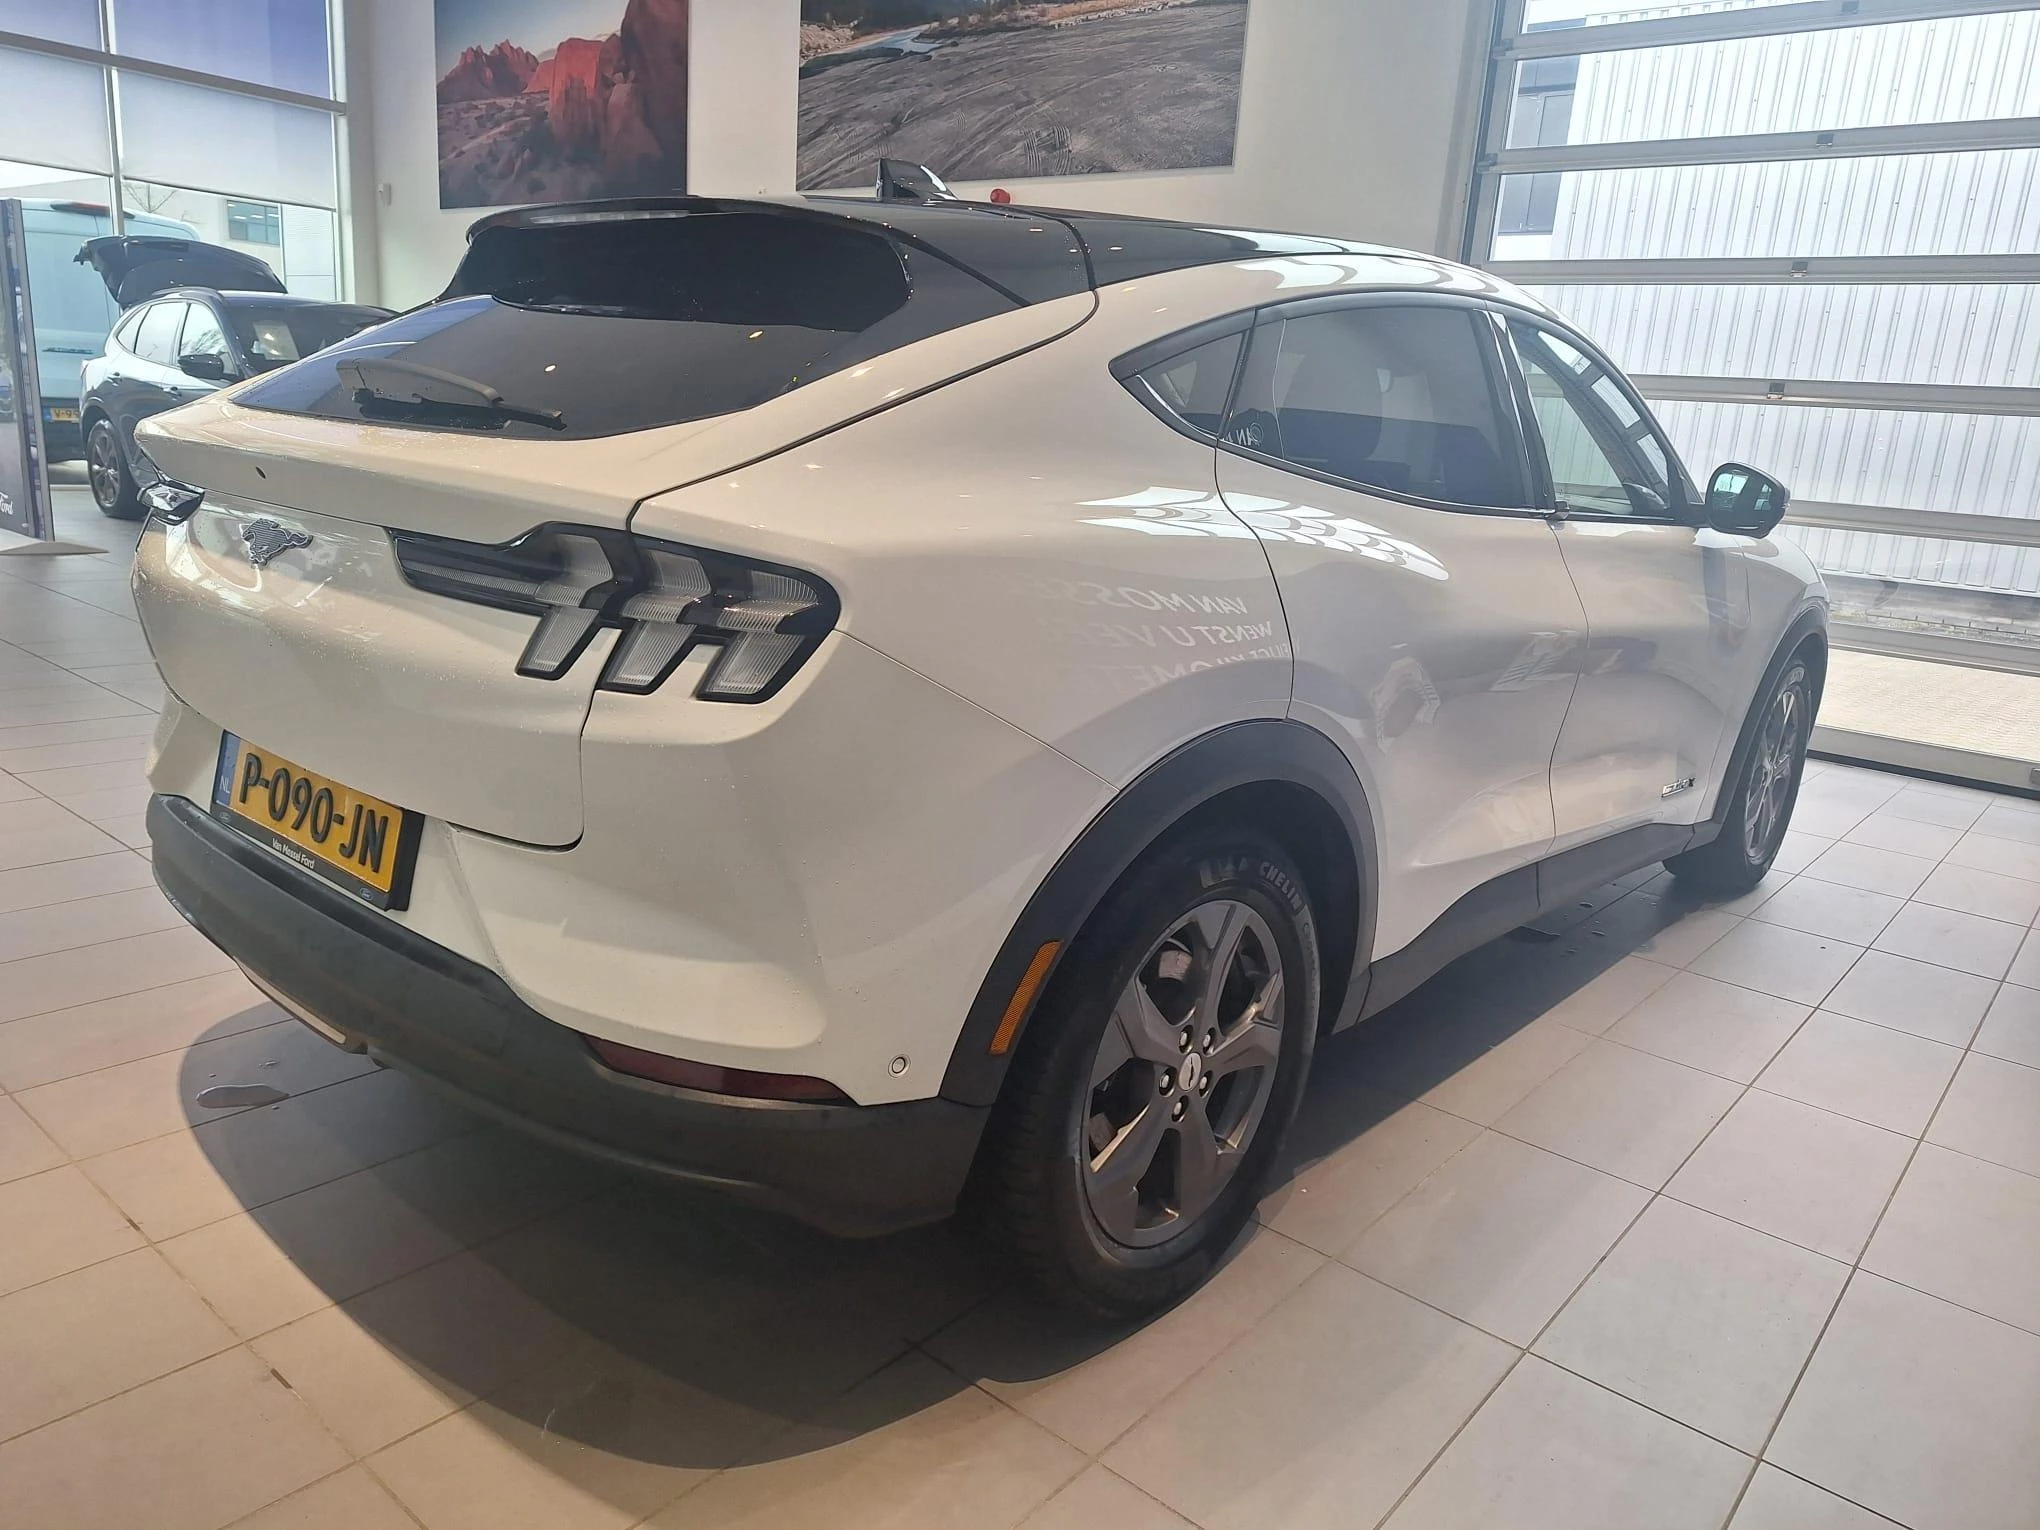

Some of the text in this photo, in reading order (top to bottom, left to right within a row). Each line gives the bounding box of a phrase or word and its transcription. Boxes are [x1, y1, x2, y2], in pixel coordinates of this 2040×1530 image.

[219, 775, 231, 794] NL
[239, 752, 389, 874] P-090-JN
[272, 837, 282, 852] Van
[301, 854, 315, 869] Ford
